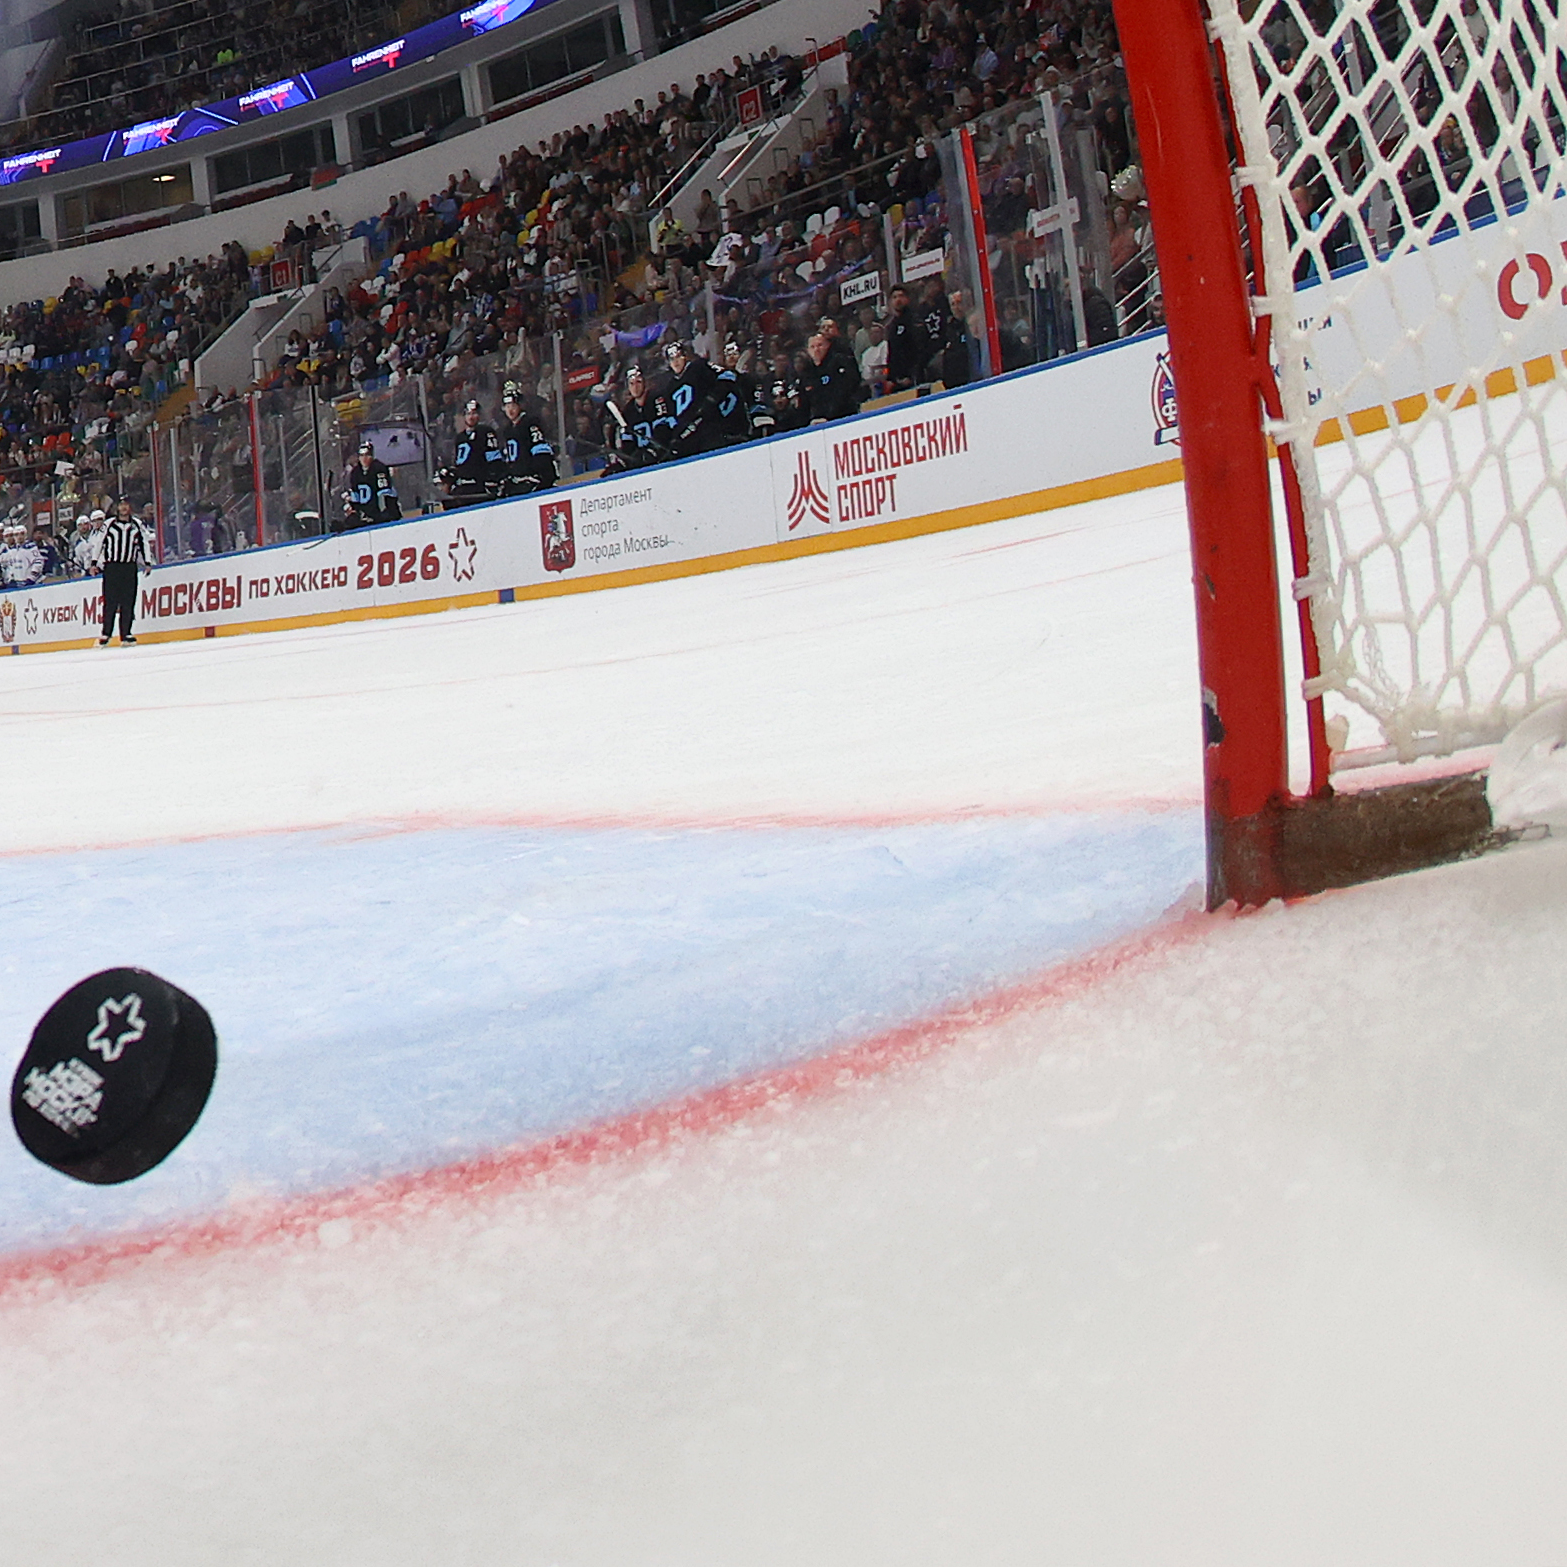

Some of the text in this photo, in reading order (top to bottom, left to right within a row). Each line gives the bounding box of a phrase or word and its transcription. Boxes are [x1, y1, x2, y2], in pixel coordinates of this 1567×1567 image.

[351, 40, 406, 69] FAHRENHEIT
[238, 81, 295, 107] FAHRENHEIT
[3, 149, 62, 170] FAHRENHEIT
[842, 277, 879, 300] KHL.RU
[833, 404, 969, 480] МОСКОВСКИЙ
[579, 486, 653, 518] Департамент
[837, 473, 897, 523] СПОРТ
[581, 518, 619, 539] спорта
[583, 534, 668, 563] города Москвы
[42, 603, 79, 625] КУБОК
[141, 574, 242, 620] МОСКВЫ
[248, 579, 271, 600] ПО
[274, 566, 348, 595] ХОККЕЮ
[355, 543, 441, 591] 2026
